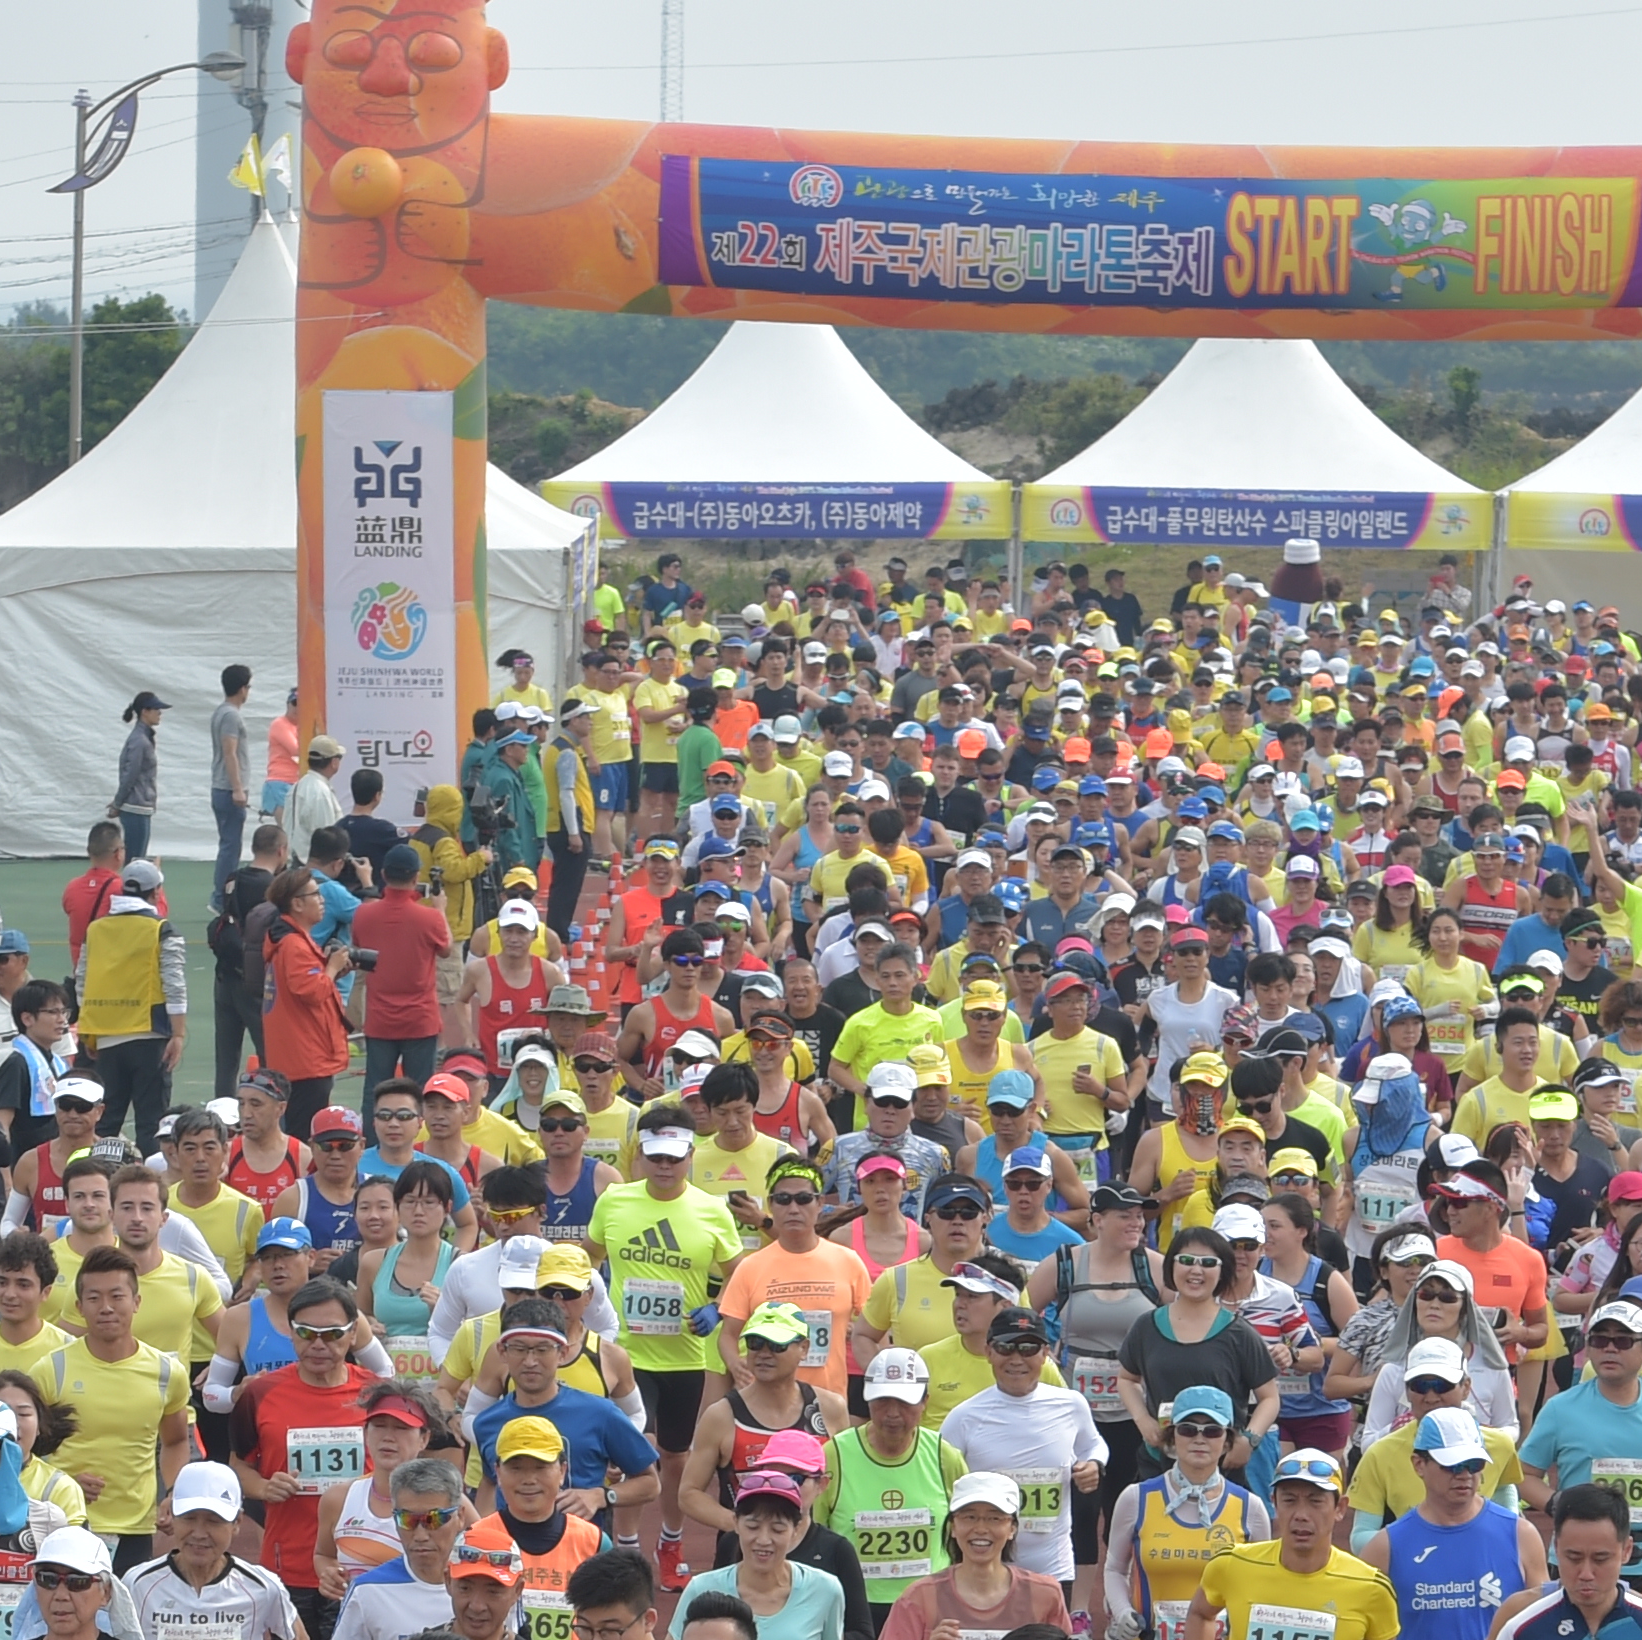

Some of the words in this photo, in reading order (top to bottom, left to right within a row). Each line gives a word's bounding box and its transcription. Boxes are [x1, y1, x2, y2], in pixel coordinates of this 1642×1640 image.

[711, 221, 806, 270] 제22회
[815, 217, 1214, 296] 제주국제관광마라톤축제
[1224, 192, 1360, 297] START
[1474, 193, 1613, 296] FINISH
[821, 501, 924, 531] (주)동아제약
[1272, 509, 1410, 540] 스파클링아일랜드
[354, 515, 422, 544] 蓝鼎
[354, 545, 423, 558] LANDING
[337, 667, 358, 676] JEJU
[360, 667, 408, 676] SHINHWA
[410, 668, 444, 677] WORLD
[619, 1246, 691, 1270] adidas
[624, 1294, 682, 1319] 1058
[291, 1446, 358, 1474] 1131
[858, 1530, 927, 1554] 2230
[1416, 1582, 1474, 1595] Standard
[1412, 1596, 1475, 1609] Chartered
[153, 1612, 183, 1625] run
[190, 1612, 207, 1625] to
[215, 1610, 245, 1625] live
